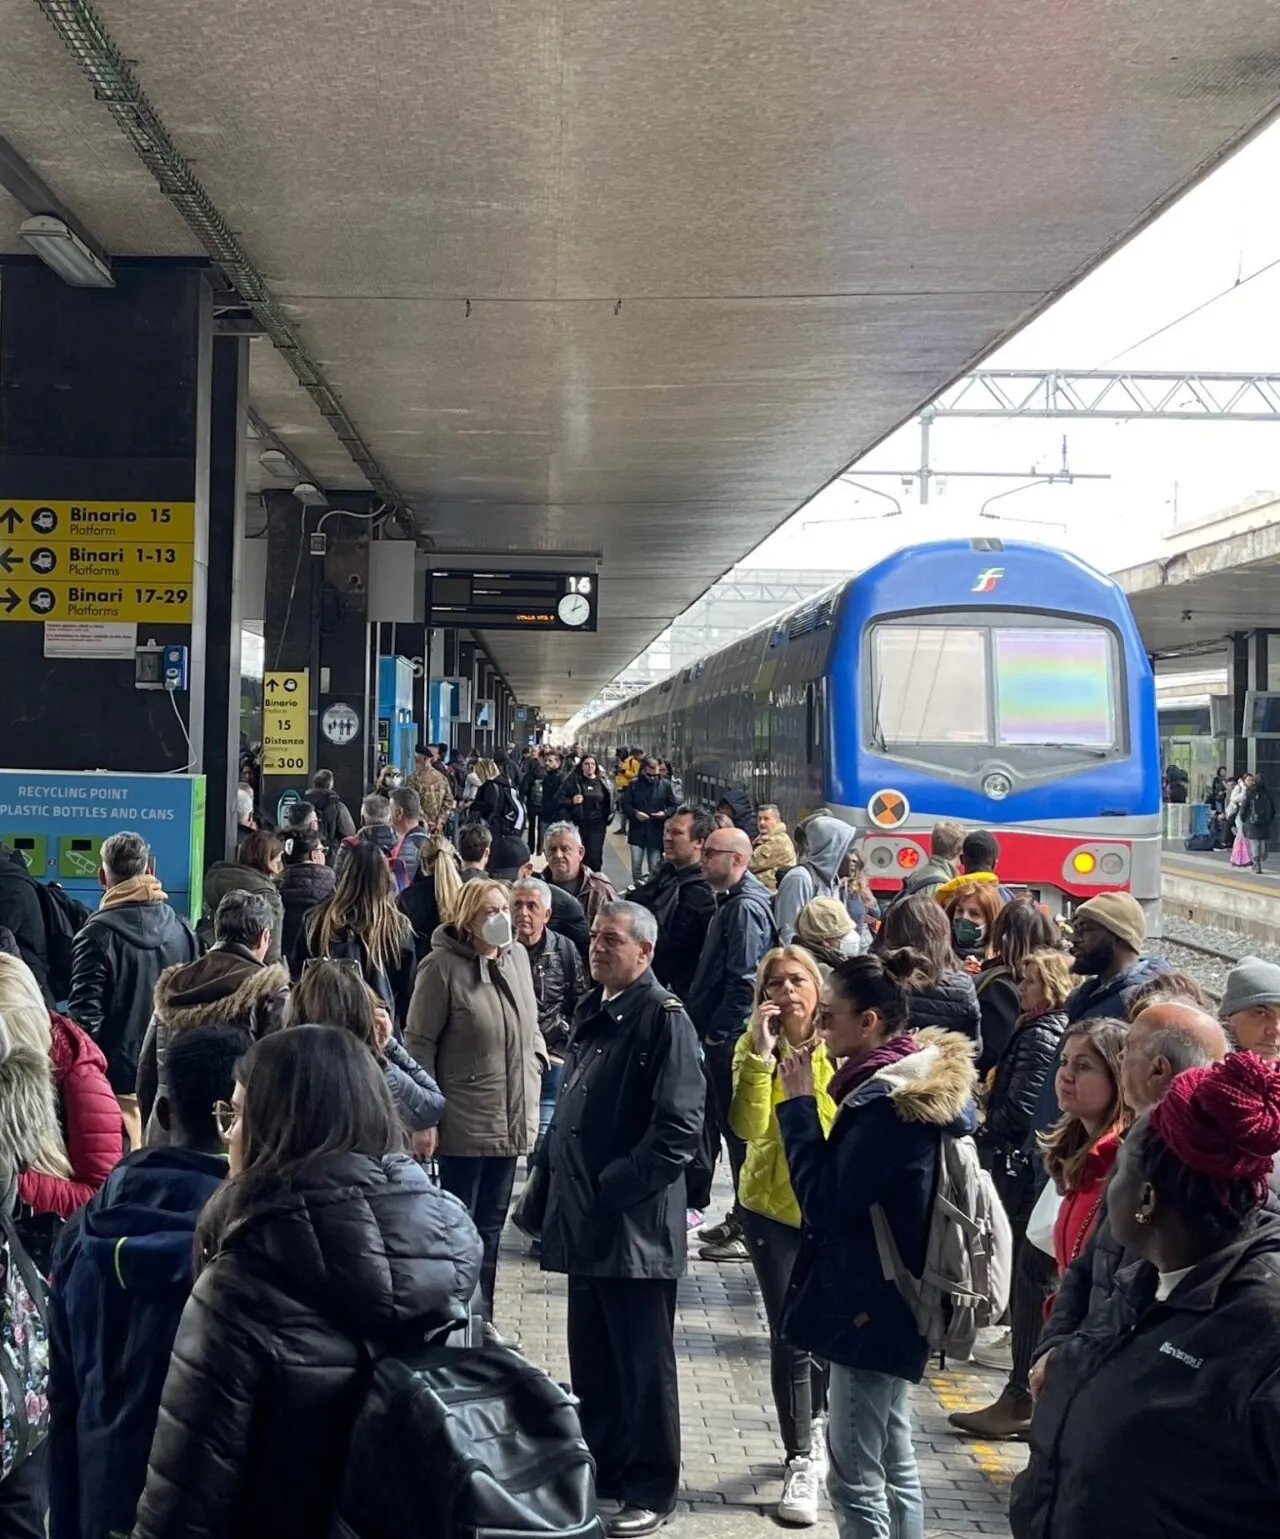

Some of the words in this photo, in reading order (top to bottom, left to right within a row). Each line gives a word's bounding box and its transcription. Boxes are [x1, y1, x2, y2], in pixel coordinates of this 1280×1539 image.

[70, 508, 136, 522] Binario
[151, 508, 171, 523] 15
[70, 524, 115, 536] Platform
[69, 547, 123, 562] Binari
[137, 548, 176, 563] 1-13
[69, 564, 120, 576] Platforms
[569, 577, 592, 594] 16
[68, 587, 122, 602] Binari
[135, 589, 188, 604] 17-29
[68, 604, 118, 616] Platforms
[265, 699, 298, 707] Binario
[277, 720, 291, 730] 15
[264, 737, 305, 745] Distanza
[278, 758, 304, 768] 300
[18, 786, 87, 799] RECYCLING
[90, 788, 129, 800] POINT
[0, 804, 49, 817] PLASTIC
[53, 806, 107, 819] BOTTLES
[110, 807, 137, 819] AND
[140, 808, 174, 821] CANS
